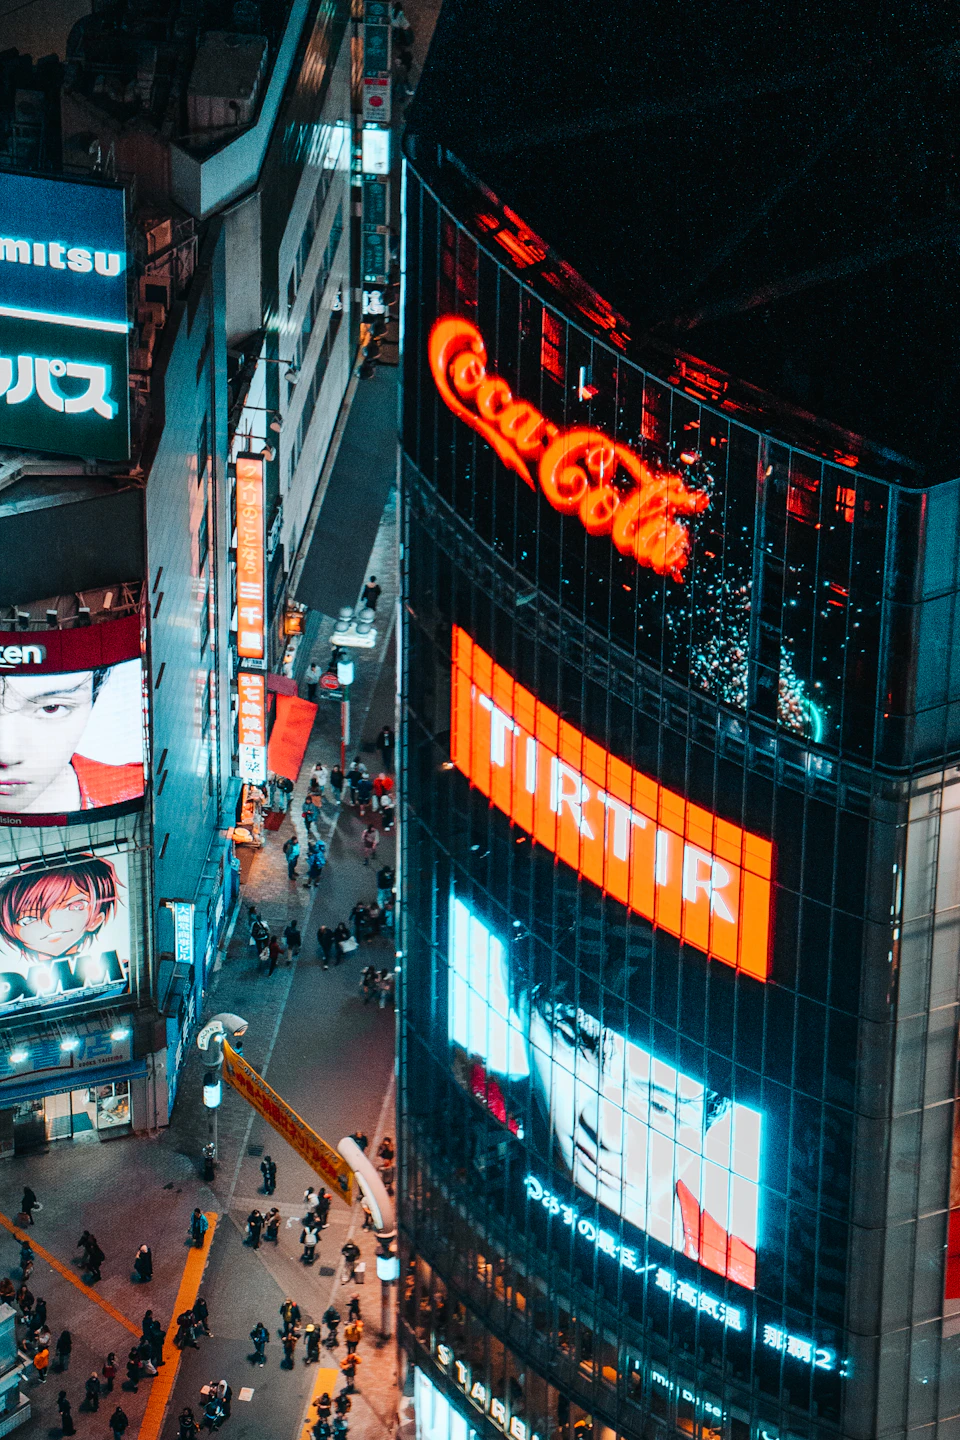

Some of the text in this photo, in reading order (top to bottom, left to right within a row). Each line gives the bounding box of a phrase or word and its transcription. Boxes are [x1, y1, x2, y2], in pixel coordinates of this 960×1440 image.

[242, 464, 259, 575] クスリのことなら
[427, 315, 708, 584] Coca-Cola
[471, 682, 737, 925] TIRTIR
